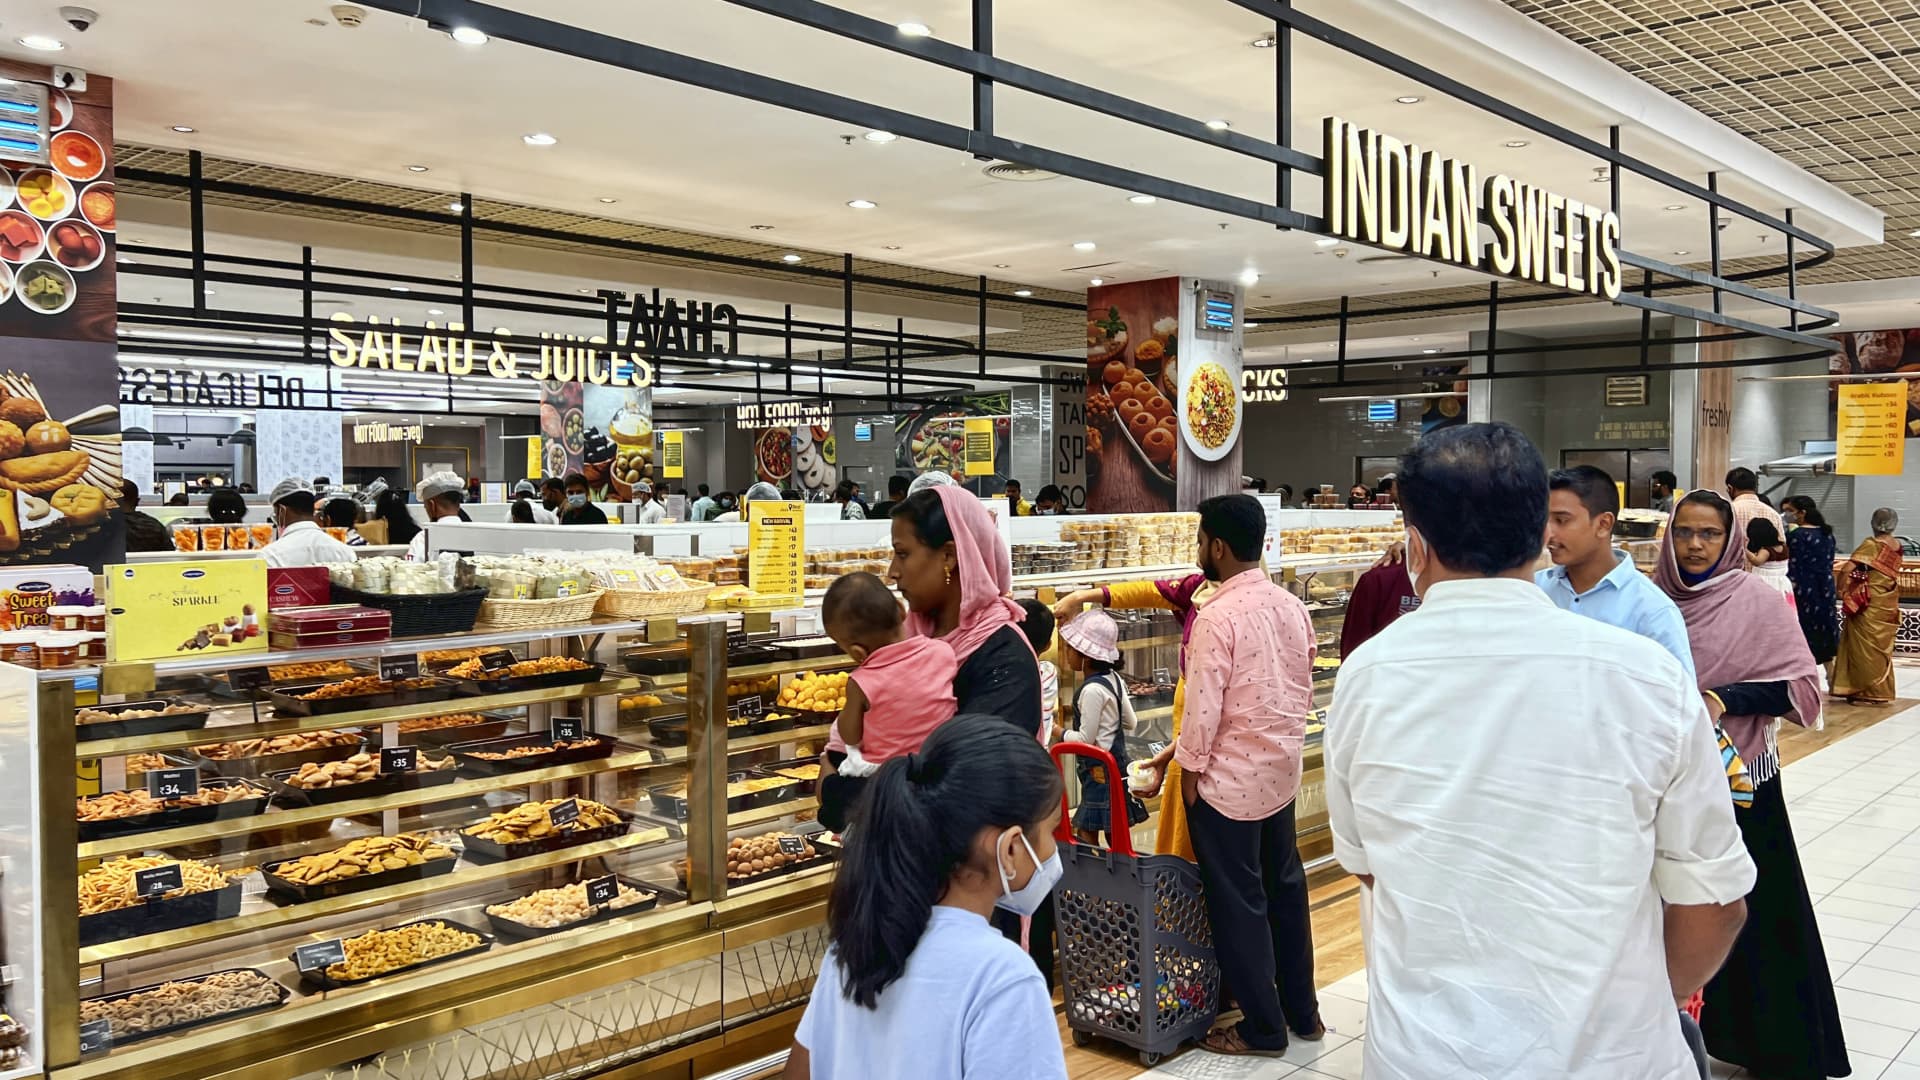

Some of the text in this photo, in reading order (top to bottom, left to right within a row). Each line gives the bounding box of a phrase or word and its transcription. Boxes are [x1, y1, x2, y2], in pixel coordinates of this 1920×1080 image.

[1323, 117, 1622, 299] INDIAN SWEETS
[328, 312, 653, 388] SALAD & JUICES
[1242, 368, 1286, 402] CKS
[736, 405, 759, 429] HOT
[762, 402, 801, 427] FOOD
[1702, 400, 1732, 434] freshly
[354, 425, 369, 444] HOT
[368, 423, 388, 443] FOOD
[1060, 435, 1083, 474] SP
[10, 591, 56, 610] Sweet
[172, 595, 219, 607] SPARKLE
